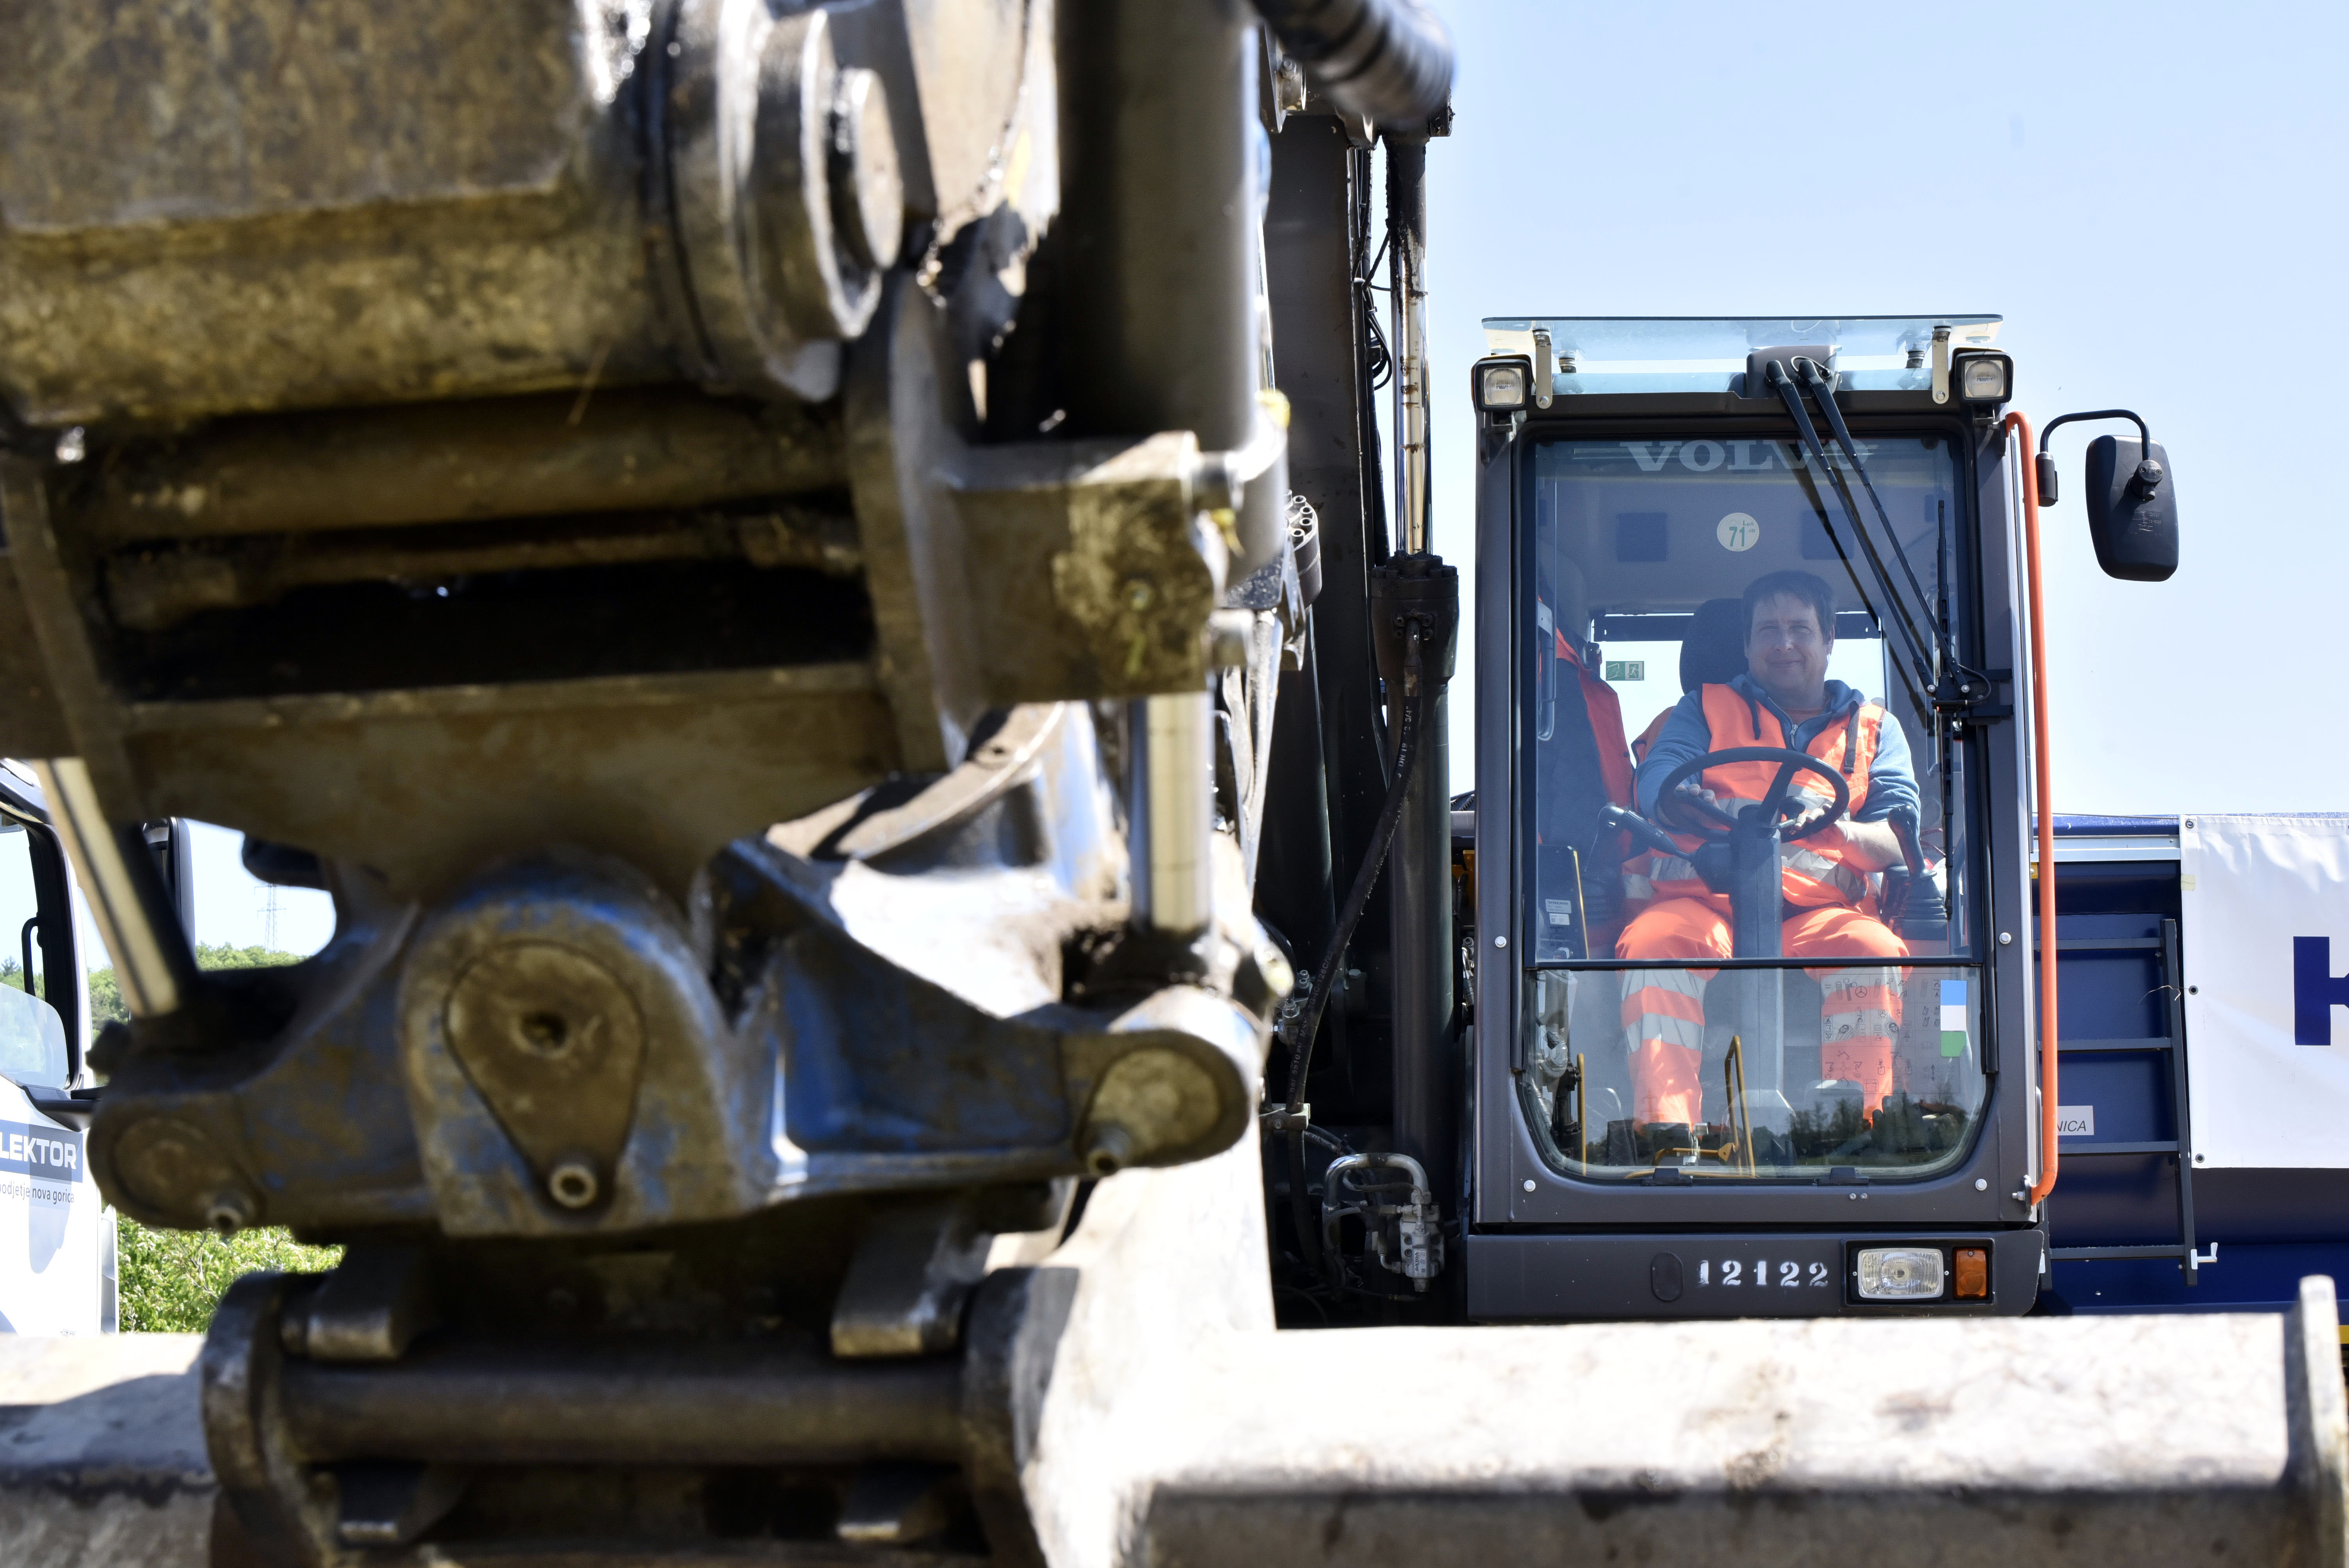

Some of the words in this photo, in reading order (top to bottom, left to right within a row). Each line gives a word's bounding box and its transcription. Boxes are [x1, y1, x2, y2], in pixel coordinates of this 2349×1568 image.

[1620, 440, 1869, 471] VOLVO
[1729, 526, 1745, 547] 71
[0, 1131, 77, 1170] LEKTOR
[32, 1188, 50, 1200] nova
[53, 1189, 74, 1205] gorica
[1698, 1260, 1829, 1287] 12122
